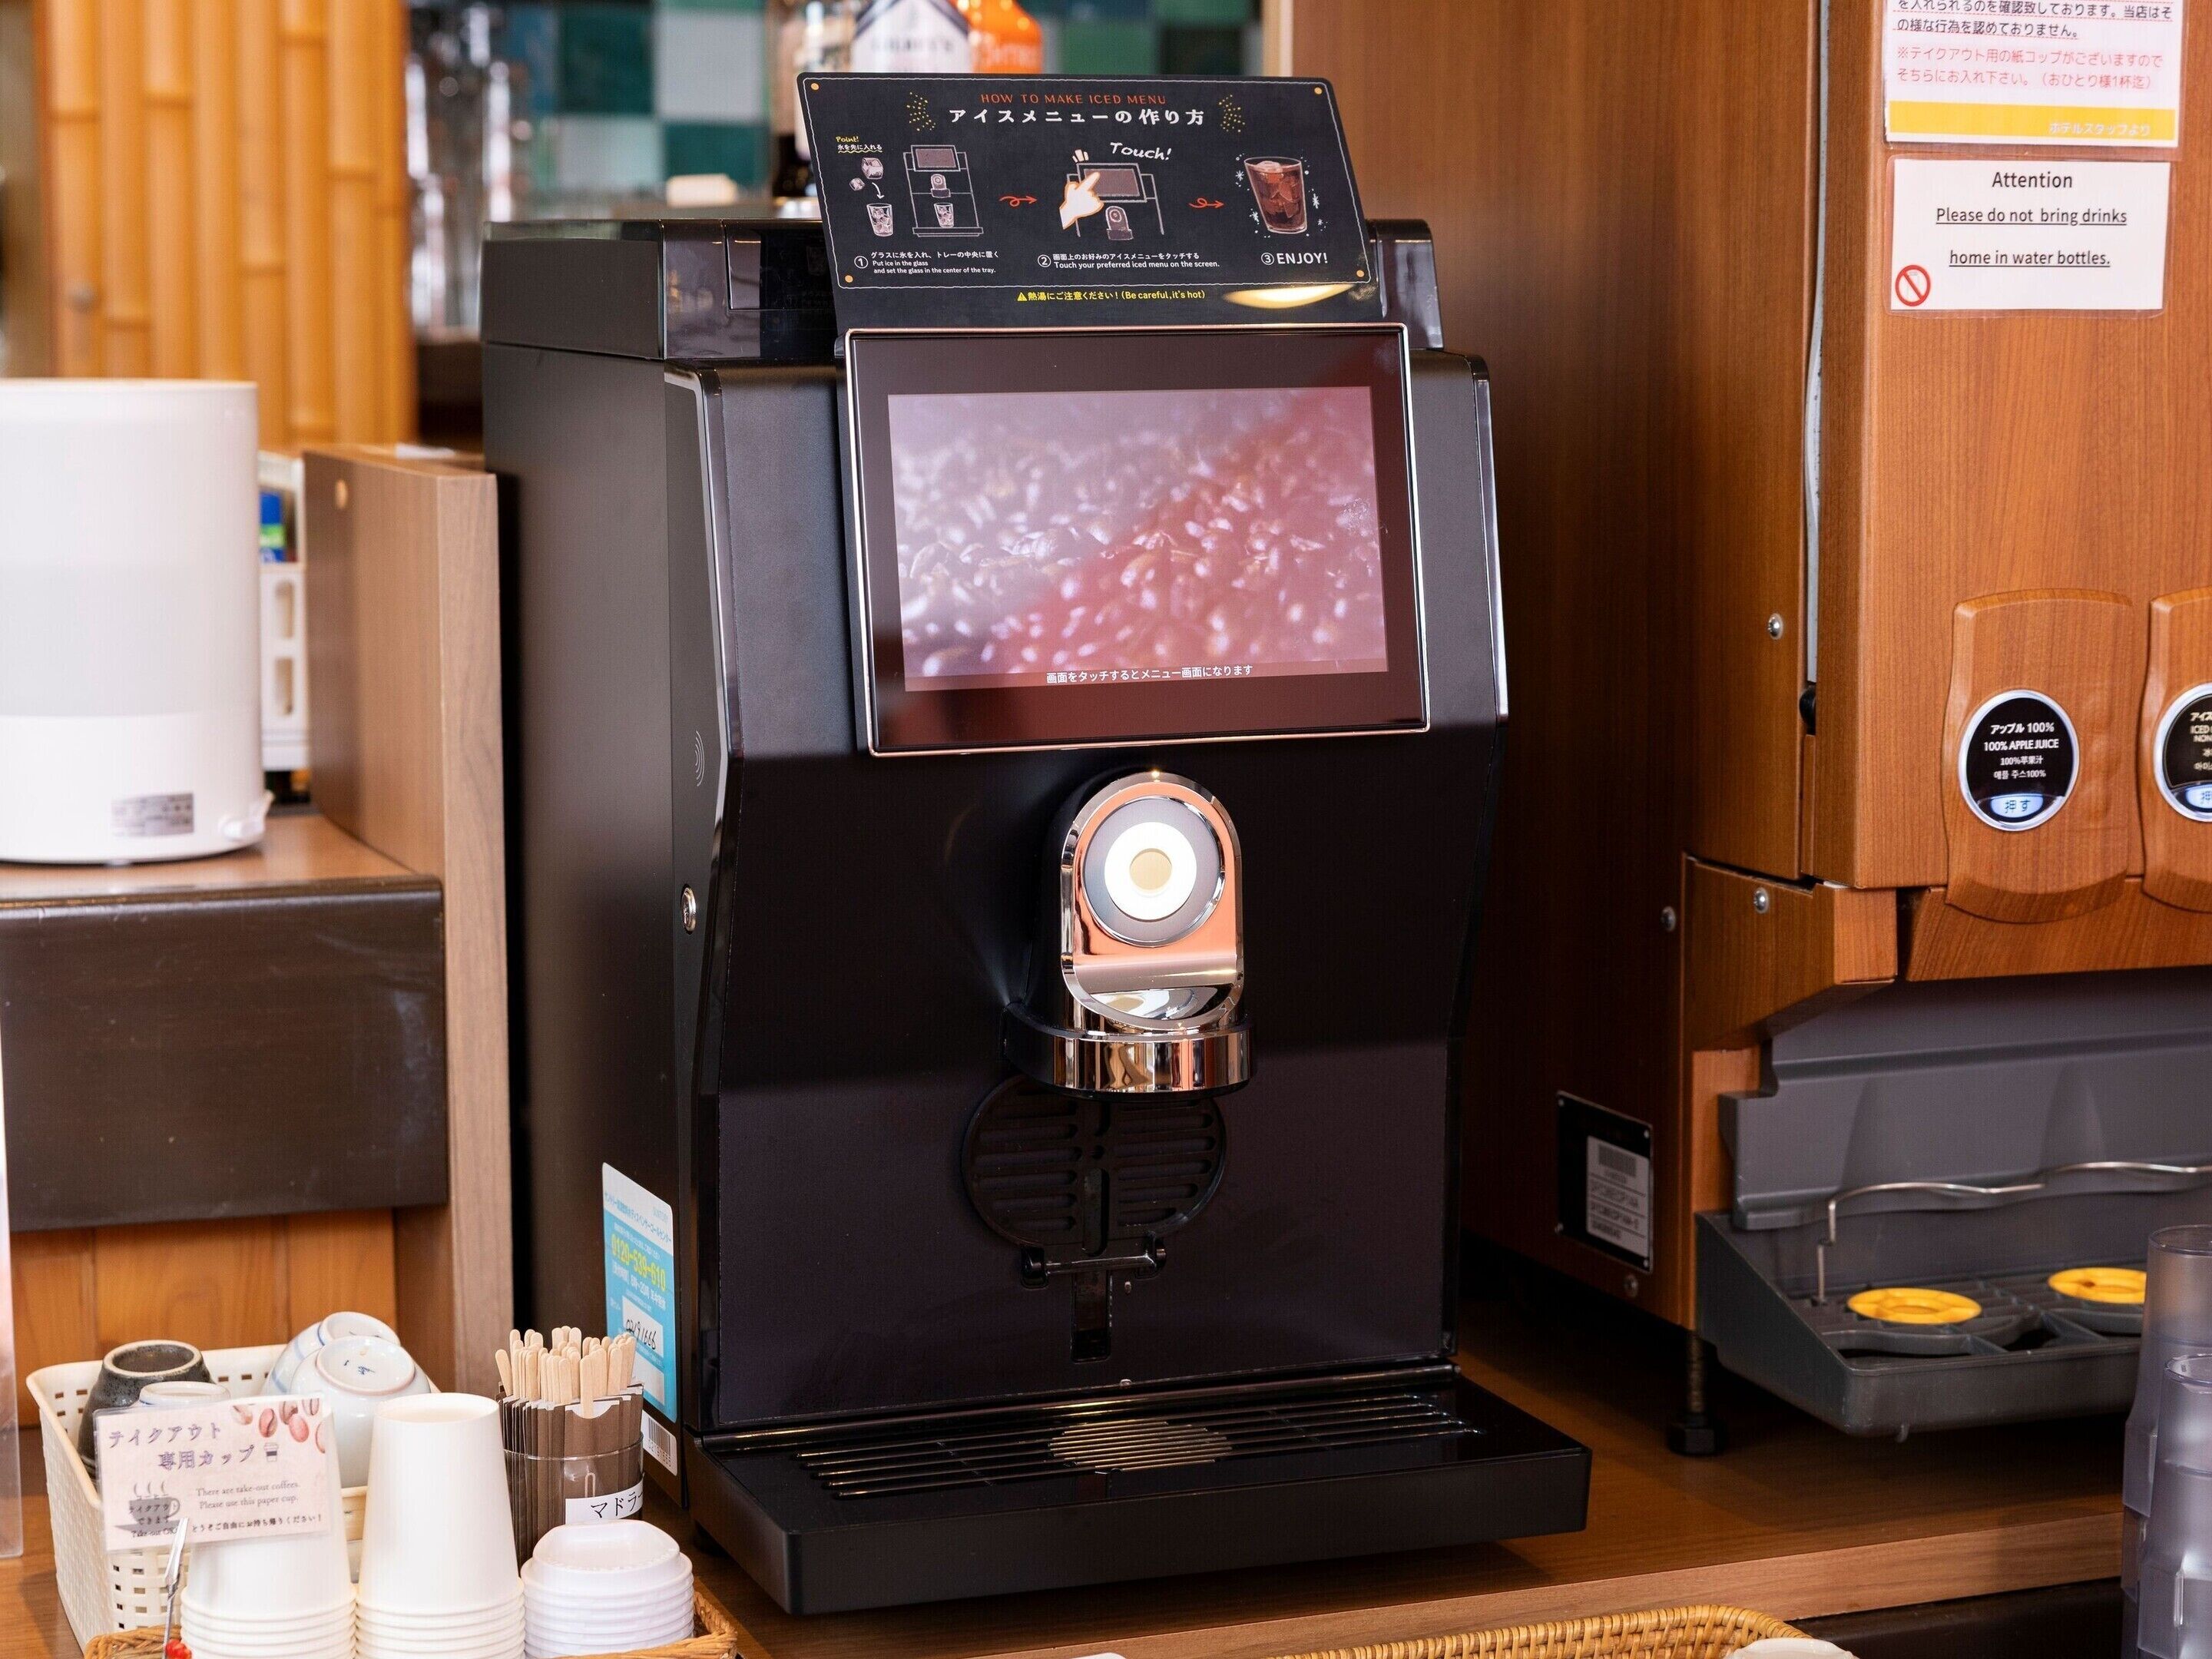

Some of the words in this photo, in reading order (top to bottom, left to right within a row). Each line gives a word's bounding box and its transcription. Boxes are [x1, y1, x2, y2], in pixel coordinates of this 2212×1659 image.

[1897, 18, 2078, 38] の様な行為を認めておりません。
[981, 94, 1013, 104] HOW
[1022, 94, 1039, 104] TO
[1045, 94, 1082, 104] MAKE
[1089, 94, 1121, 105] ICED
[1127, 94, 1167, 105] MENU
[949, 108, 1204, 126] アイスメニューの作り方
[1110, 142, 1172, 161] Touch!
[1992, 171, 2073, 188] Attention
[1936, 207, 1983, 223] Please
[1987, 207, 2005, 223] do
[2009, 210, 2034, 223] not
[2041, 207, 2078, 227] bring
[2082, 208, 2128, 223] drinks
[1052, 253, 1200, 261] 画面上のお好みのアイスメニューをタッチする
[1949, 250, 1991, 264] home
[1995, 250, 2008, 264] in
[2012, 252, 2054, 264] water
[2057, 250, 2111, 265] bottles.
[1187, 290, 1206, 300] hot)
[1046, 664, 1253, 684] 画面をタッチするとメニュー画面になります
[1990, 723, 2025, 735] アップル
[2027, 722, 2055, 733] 100%
[1983, 741, 2008, 751] 100%
[2008, 740, 2034, 750] APPLE
[2034, 739, 2059, 750] JUICE
[2005, 799, 2031, 813] 押す
[109, 1422, 221, 1449] テイクアウト
[158, 1444, 255, 1471] 専用カップ
[196, 1486, 219, 1497] There
[200, 1500, 226, 1509] Please
[240, 1498, 254, 1506] this
[257, 1498, 279, 1508] paper
[281, 1495, 299, 1505] cup.
